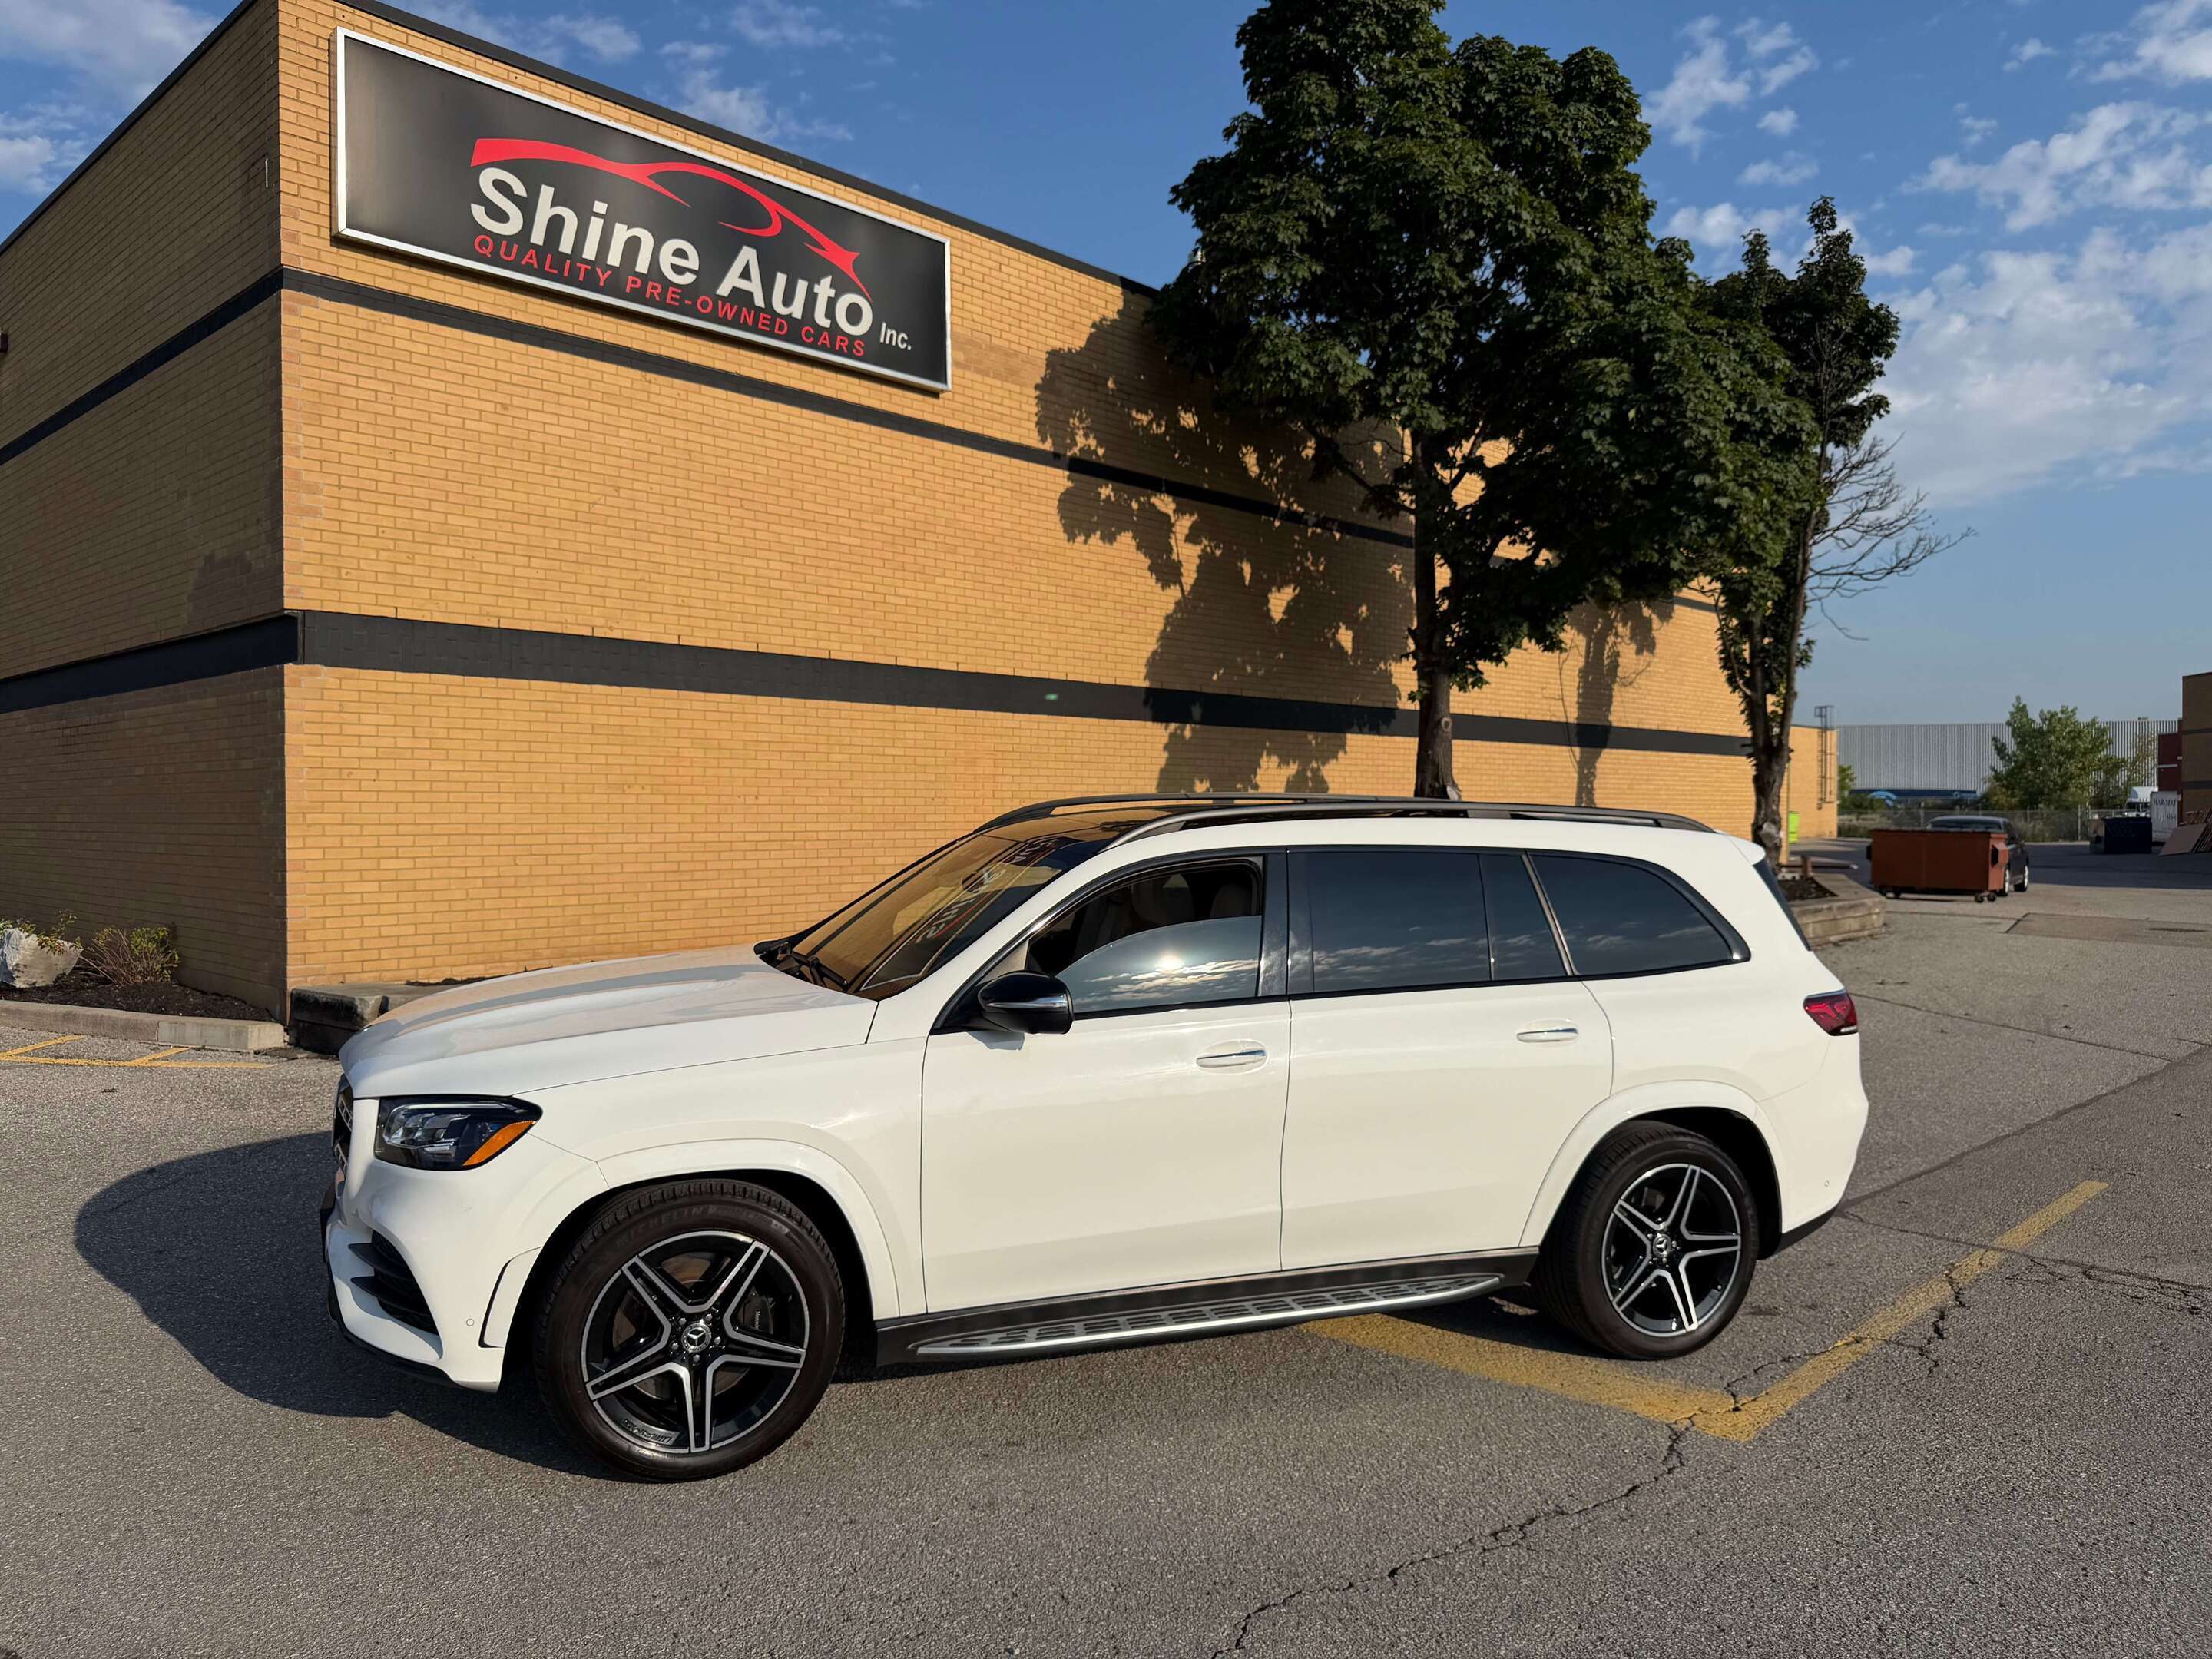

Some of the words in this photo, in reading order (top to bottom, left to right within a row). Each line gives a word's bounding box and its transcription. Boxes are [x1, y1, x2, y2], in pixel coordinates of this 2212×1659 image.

[470, 167, 700, 286] Shine
[716, 244, 873, 336] Auto
[879, 322, 912, 351] Inc.
[473, 234, 612, 286] QUALITY
[625, 276, 790, 336] PRE-OWNED
[800, 326, 865, 357] CARS
